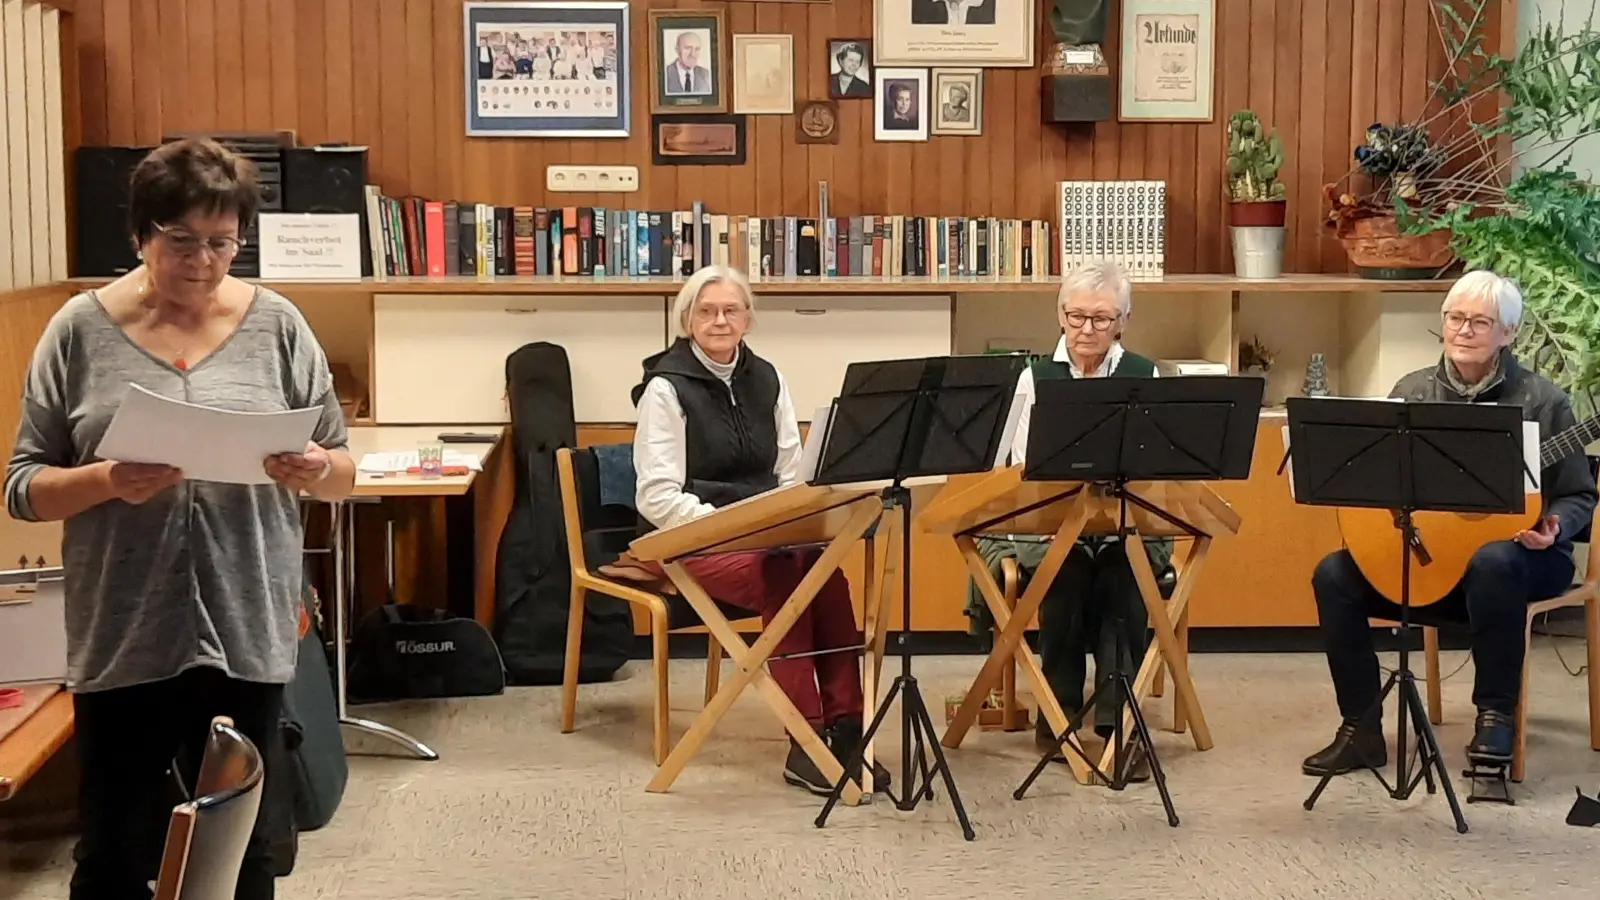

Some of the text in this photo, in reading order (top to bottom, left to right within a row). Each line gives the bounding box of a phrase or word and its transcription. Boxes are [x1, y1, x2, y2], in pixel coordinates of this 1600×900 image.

[1144, 20, 1196, 44] Urkunde
[1085, 217, 1093, 255] LEXIKON
[1096, 217, 1104, 255] LEXIKON
[1116, 217, 1124, 255] LEXIKON
[1147, 217, 1155, 255] LEXIKON
[1157, 217, 1165, 255] LEXIKON
